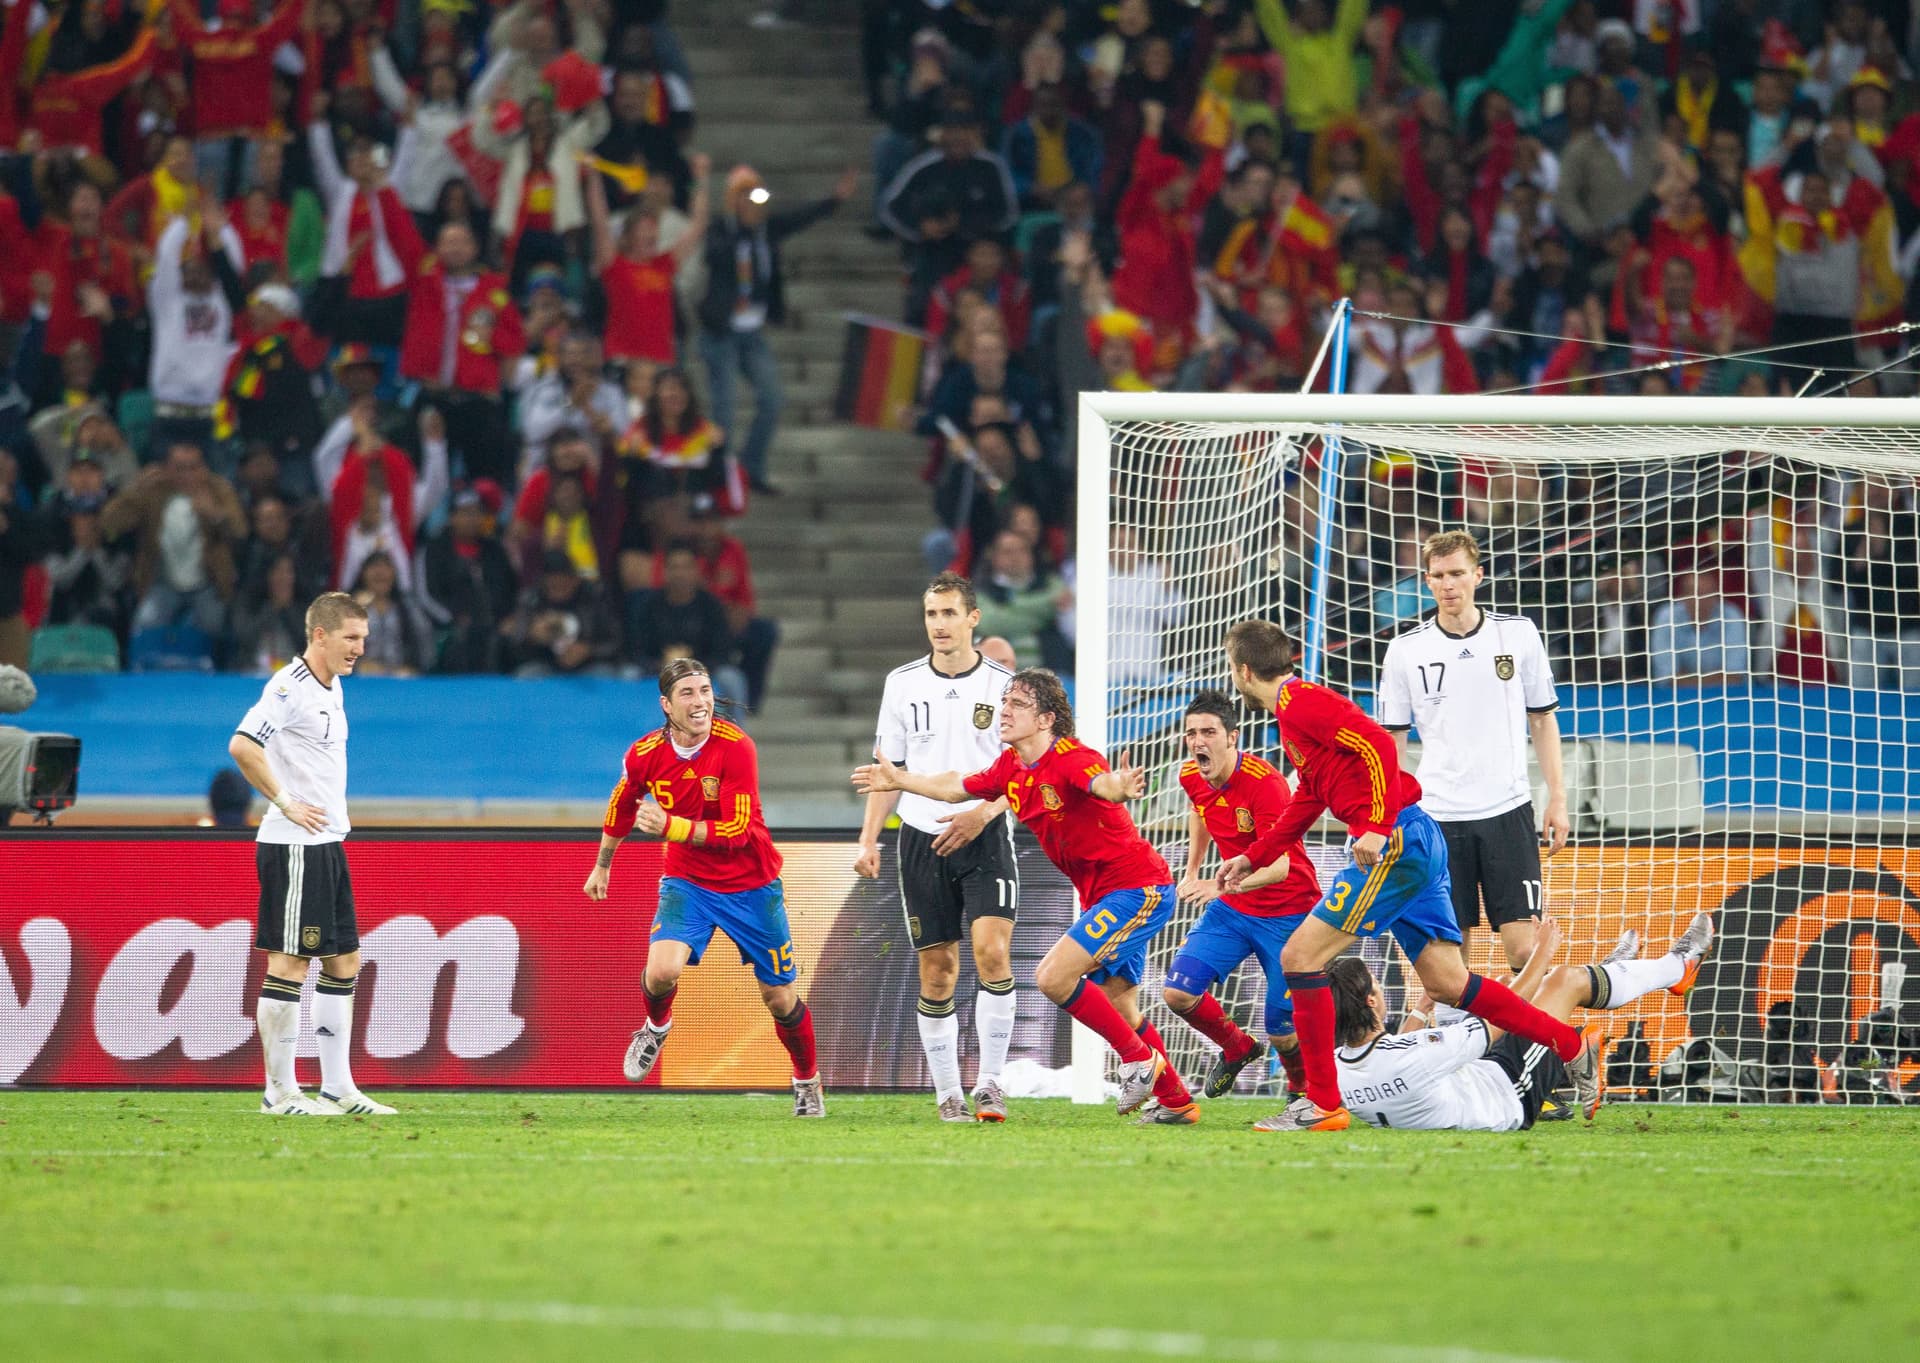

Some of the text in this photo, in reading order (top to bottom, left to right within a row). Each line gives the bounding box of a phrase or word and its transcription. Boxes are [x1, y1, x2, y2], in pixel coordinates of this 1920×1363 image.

[1418, 662, 1446, 694] 17
[320, 711, 331, 739] 7
[910, 701, 930, 733] 11
[1008, 781, 1020, 813] 5
[995, 878, 1016, 909] 11
[1325, 882, 1351, 912] 3
[1522, 880, 1541, 910] 17
[1085, 909, 1118, 939] 5
[768, 940, 795, 975] 15
